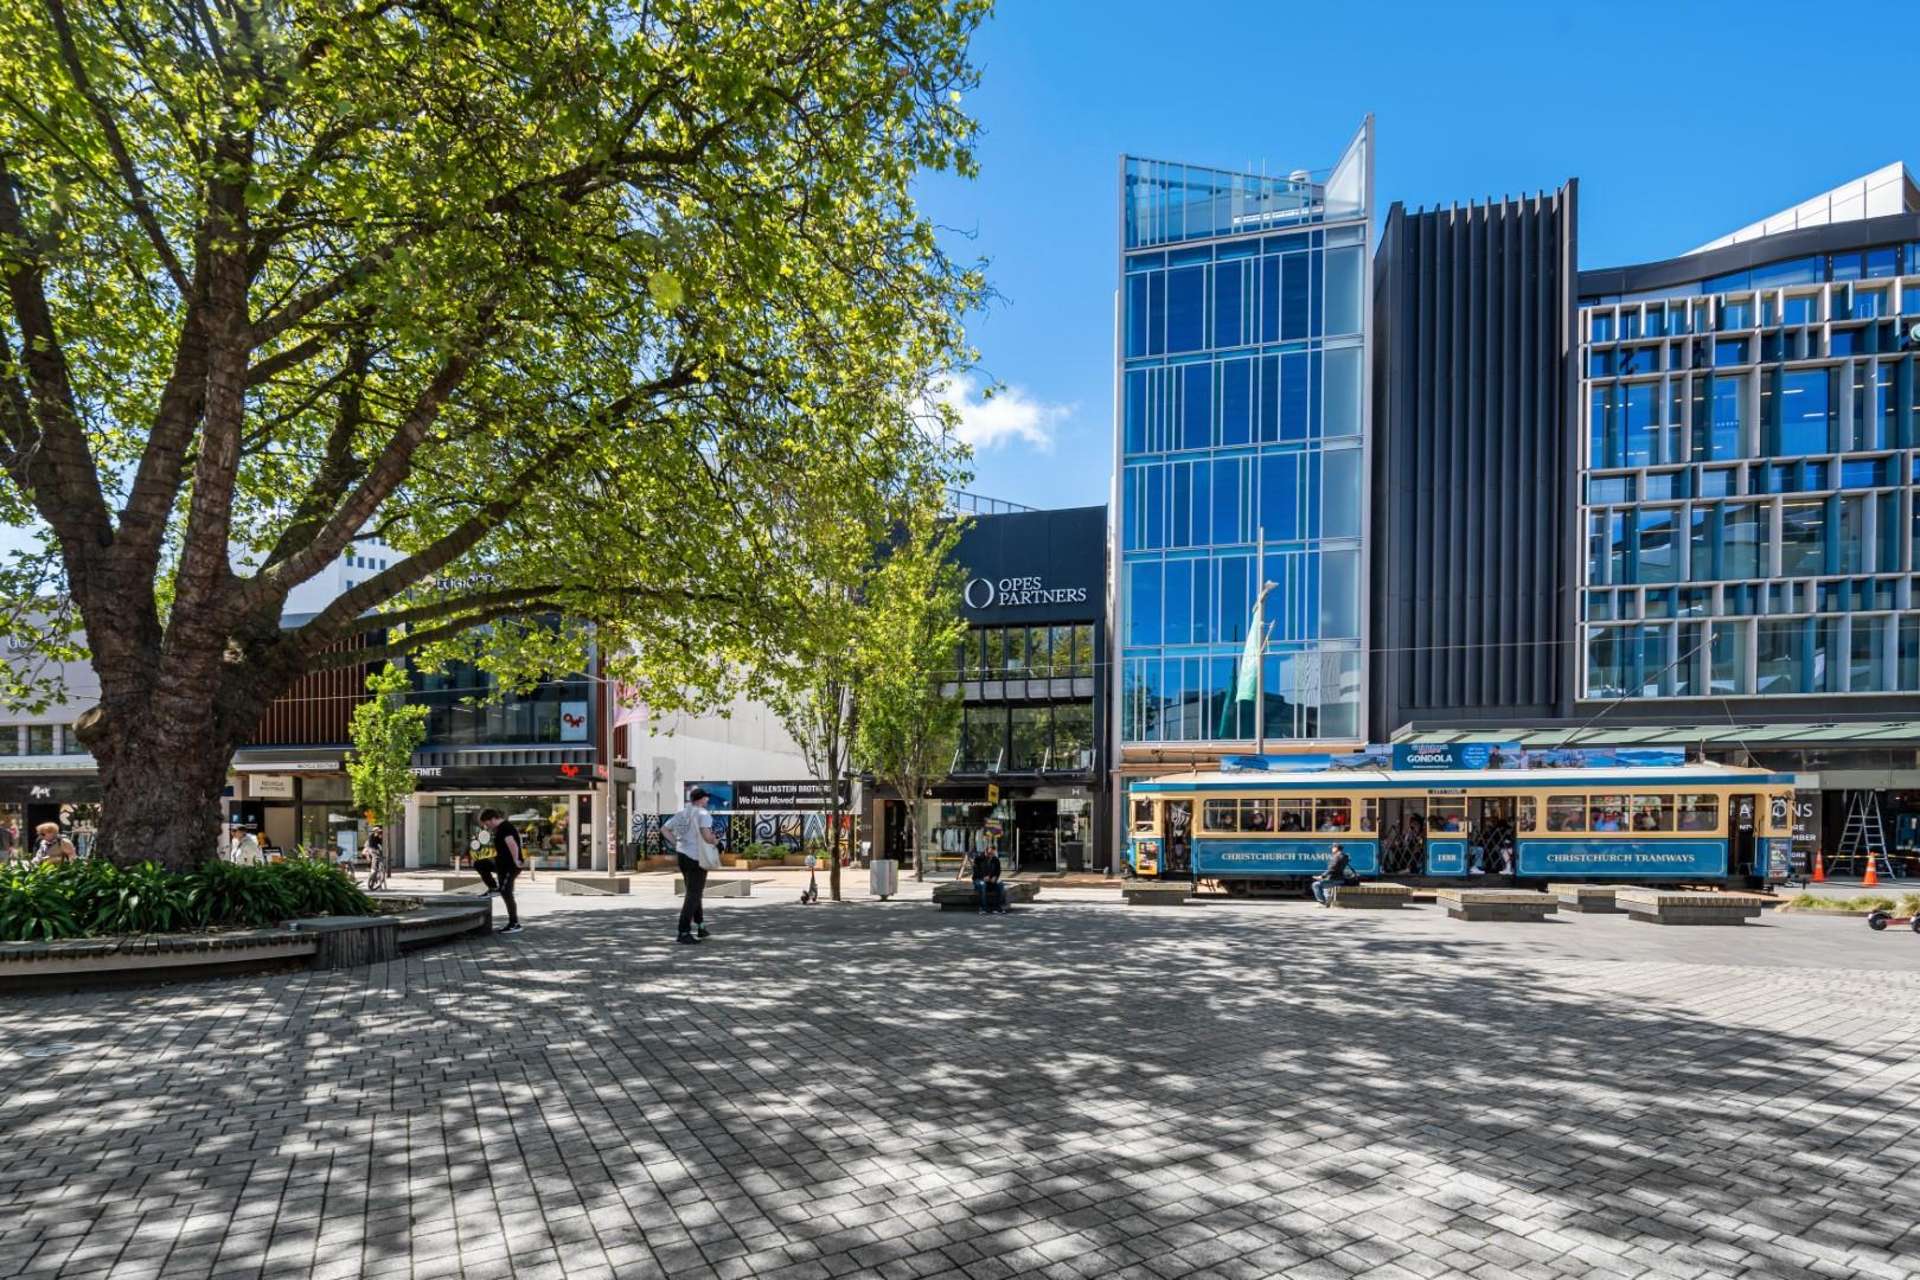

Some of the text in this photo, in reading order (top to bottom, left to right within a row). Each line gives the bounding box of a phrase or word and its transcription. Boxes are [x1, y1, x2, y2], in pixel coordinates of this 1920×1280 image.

[999, 576, 1042, 592] OPES
[998, 588, 1087, 606] PARTNERS
[1407, 754, 1453, 764] GONDOLA
[752, 785, 797, 793] HALLENSTEIN
[739, 796, 795, 804] We Have Moved
[1221, 852, 1296, 861] CHRISTCHURCH
[1546, 853, 1695, 862] CHRISTCHURCH TRAMWAYS
